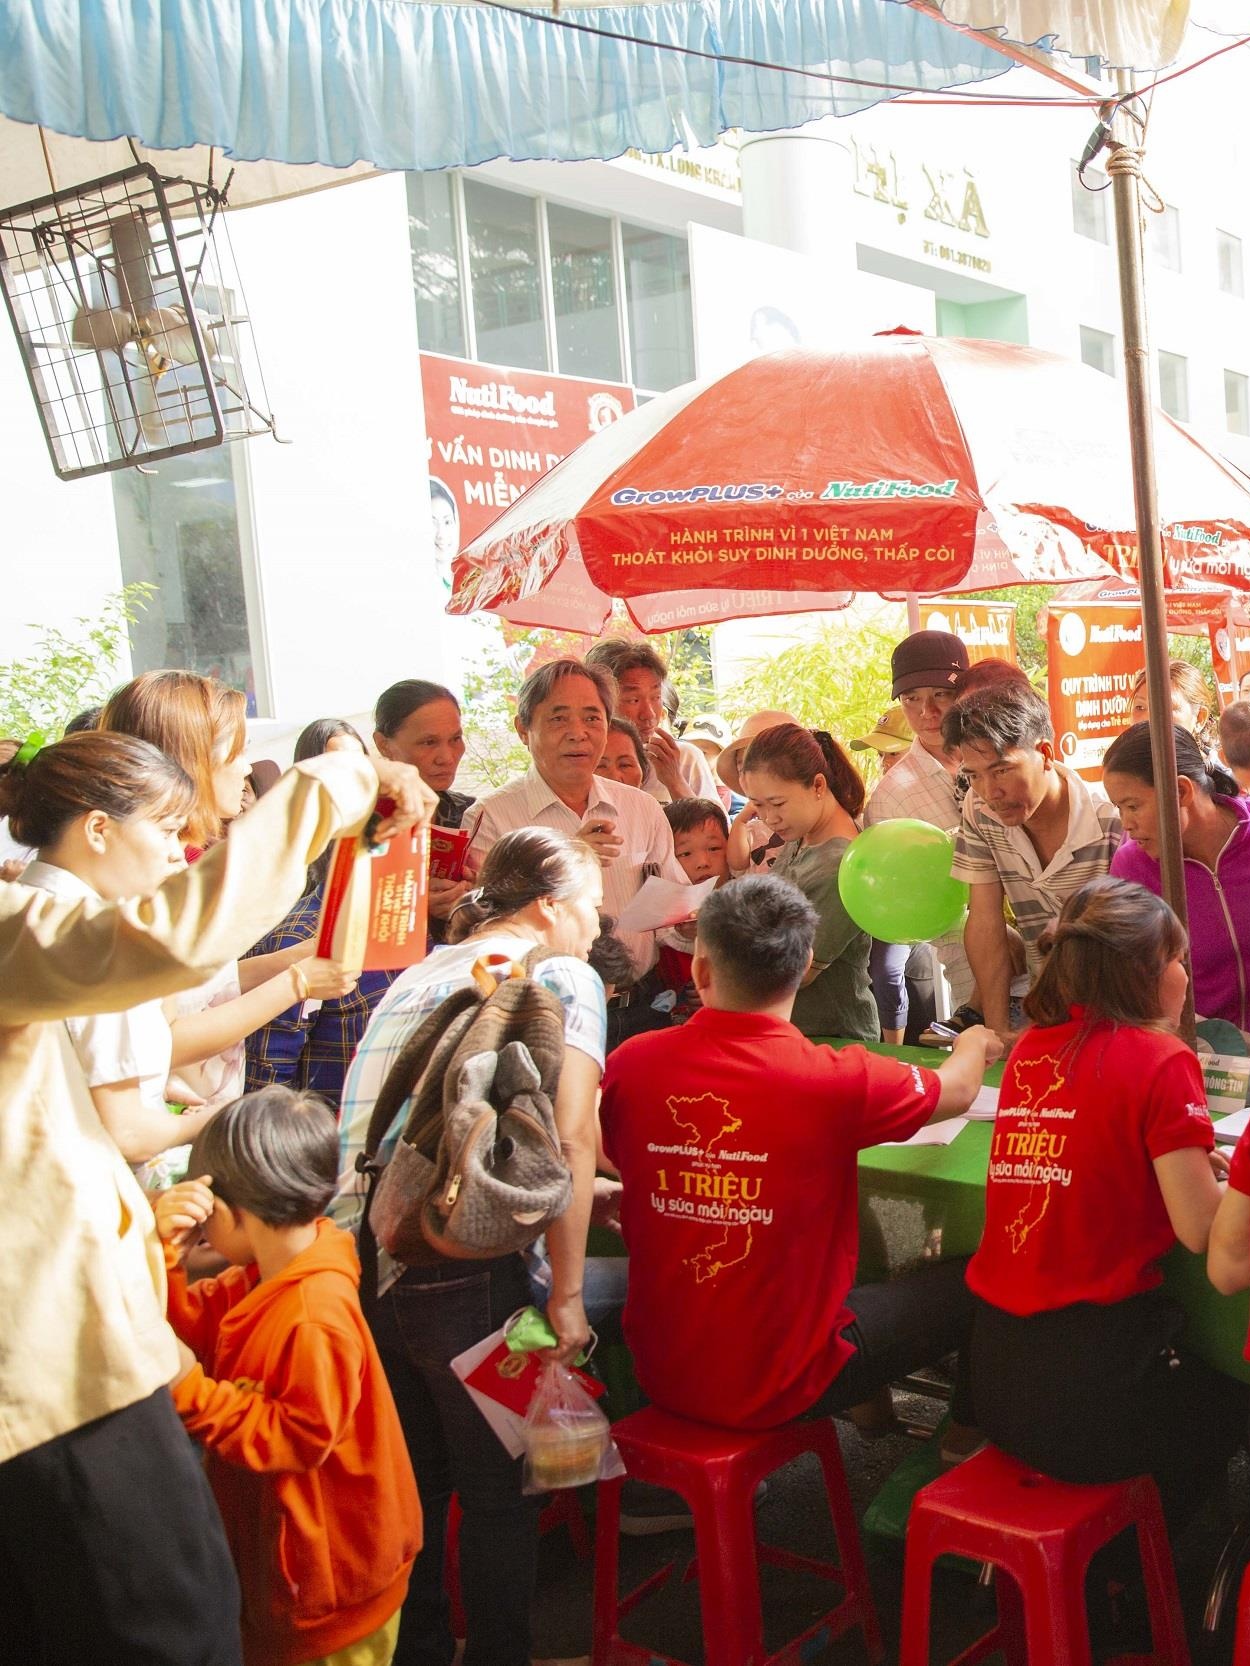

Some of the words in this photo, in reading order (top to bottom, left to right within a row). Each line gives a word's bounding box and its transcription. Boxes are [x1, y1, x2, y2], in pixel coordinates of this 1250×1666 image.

[488, 447, 542, 472] DINH
[612, 484, 784, 505] GrowPLUS+
[820, 480, 958, 501] NutiFood
[670, 526, 718, 546] HÀNH
[723, 524, 775, 544] TRÌNH
[780, 523, 797, 542] VÌ
[801, 527, 808, 542] 1
[813, 524, 850, 544] VIỆT
[855, 527, 894, 542] NAM
[612, 547, 667, 567] THOÁT
[671, 544, 714, 564] KHỎI
[718, 549, 750, 563] SUY
[755, 546, 798, 562] DINH
[801, 542, 869, 564] DƯỠNG,
[874, 542, 920, 561] THẤP
[924, 544, 956, 562] CÒI
[1083, 672, 1113, 693] TRÌNH
[1102, 693, 1132, 716] DƯỠN
[718, 1149, 769, 1163] NutiFood
[994, 1133, 1001, 1156] 1
[656, 1169, 669, 1191] 1
[1034, 1163, 1073, 1187] ngày
[650, 1192, 665, 1213] ly
[697, 1201, 725, 1219] mỗi
[728, 1204, 774, 1226] ngày
